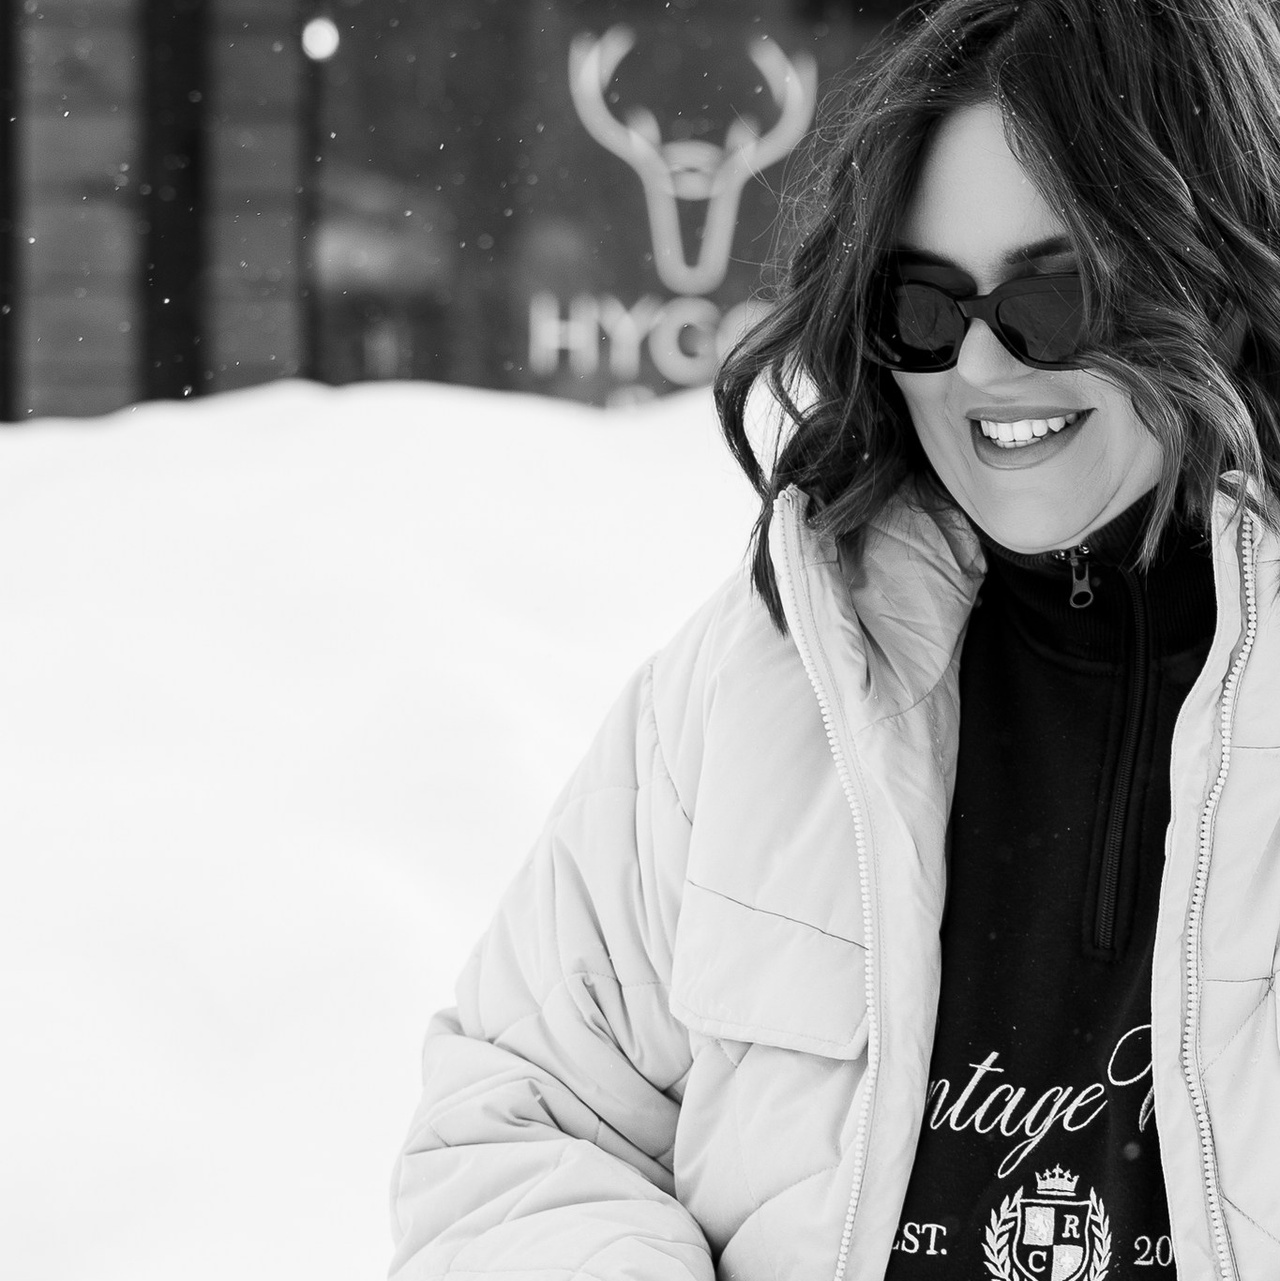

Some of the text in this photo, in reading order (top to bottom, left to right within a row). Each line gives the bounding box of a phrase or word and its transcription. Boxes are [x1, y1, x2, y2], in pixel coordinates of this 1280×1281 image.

[926, 1051, 1108, 1179] ntage
[1061, 1214, 1080, 1239] R
[1027, 1251, 1047, 1272] C
[1133, 1235, 1173, 1267] 20
